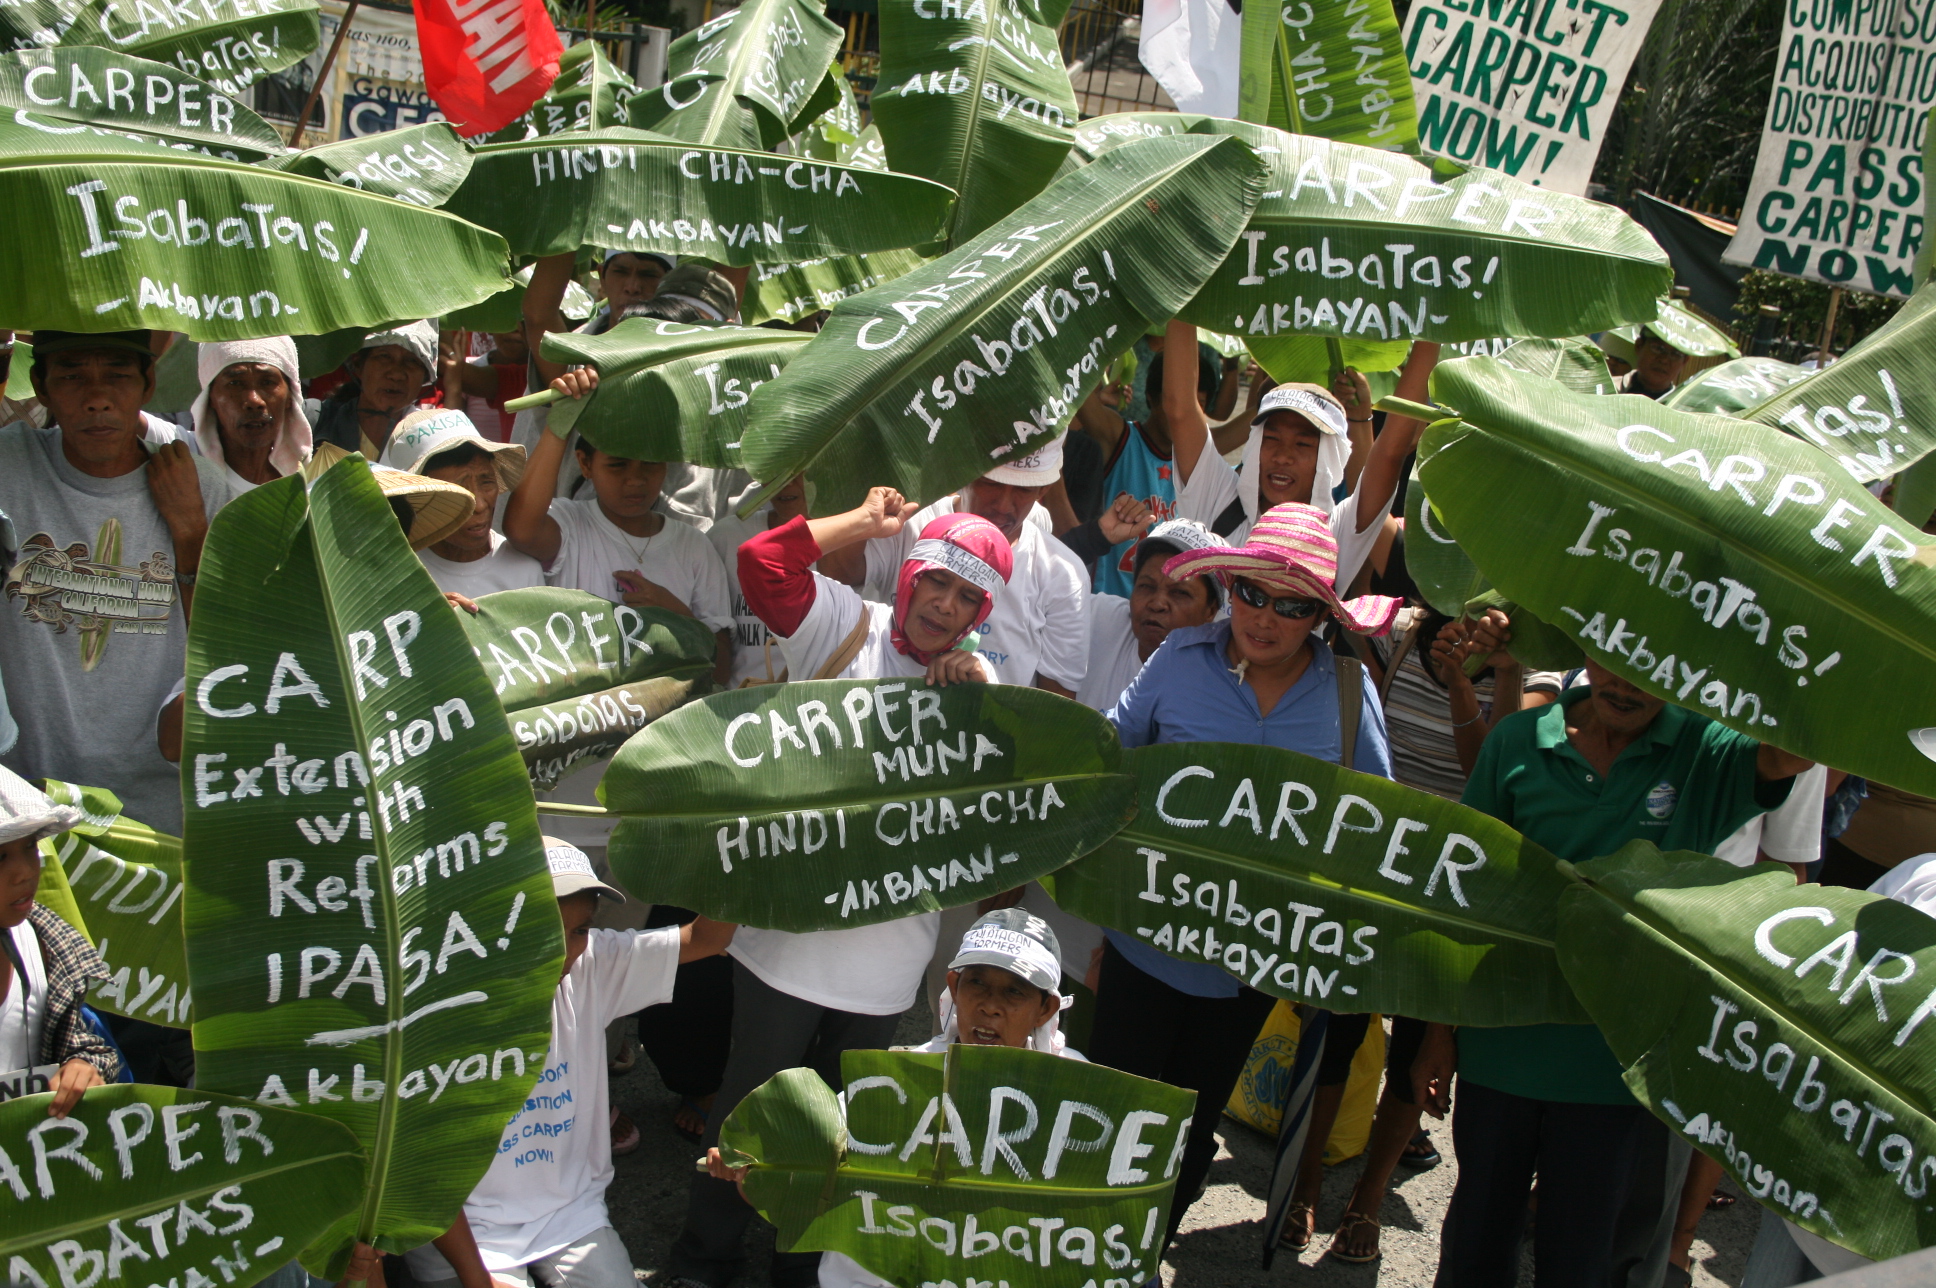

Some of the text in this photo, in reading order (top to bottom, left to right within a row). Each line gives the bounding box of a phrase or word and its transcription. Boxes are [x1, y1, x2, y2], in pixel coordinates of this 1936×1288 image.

[24, 63, 236, 136] CARPER
[355, 62, 390, 79] The
[1406, 6, 1608, 141] CARPER
[533, 147, 636, 187] HINDI
[680, 151, 862, 198] CHA-CHA
[1418, 94, 1564, 186] NOW!
[1779, 139, 1923, 208] PASS
[1756, 190, 1923, 259] CARPER
[857, 219, 1064, 351] CARPER
[1616, 424, 1918, 589] CARPER
[30, 563, 134, 599] INTERNATIONAL
[934, 552, 987, 586] FARMERS
[940, 542, 999, 584] CALATAGAN
[61, 590, 139, 618] CALIFORNIA
[197, 610, 421, 718] CARP
[474, 605, 653, 696] ARPER
[196, 698, 475, 808] Extension
[724, 682, 947, 768] CARPER
[872, 731, 1004, 784] MUNA
[297, 780, 426, 845] with
[717, 783, 1065, 873] HINDI CHA-CHA
[1155, 765, 1488, 908] CARPER
[268, 821, 509, 930] Reforms
[974, 939, 1021, 956] FARMERS
[514, 1148, 554, 1168] NOW!
